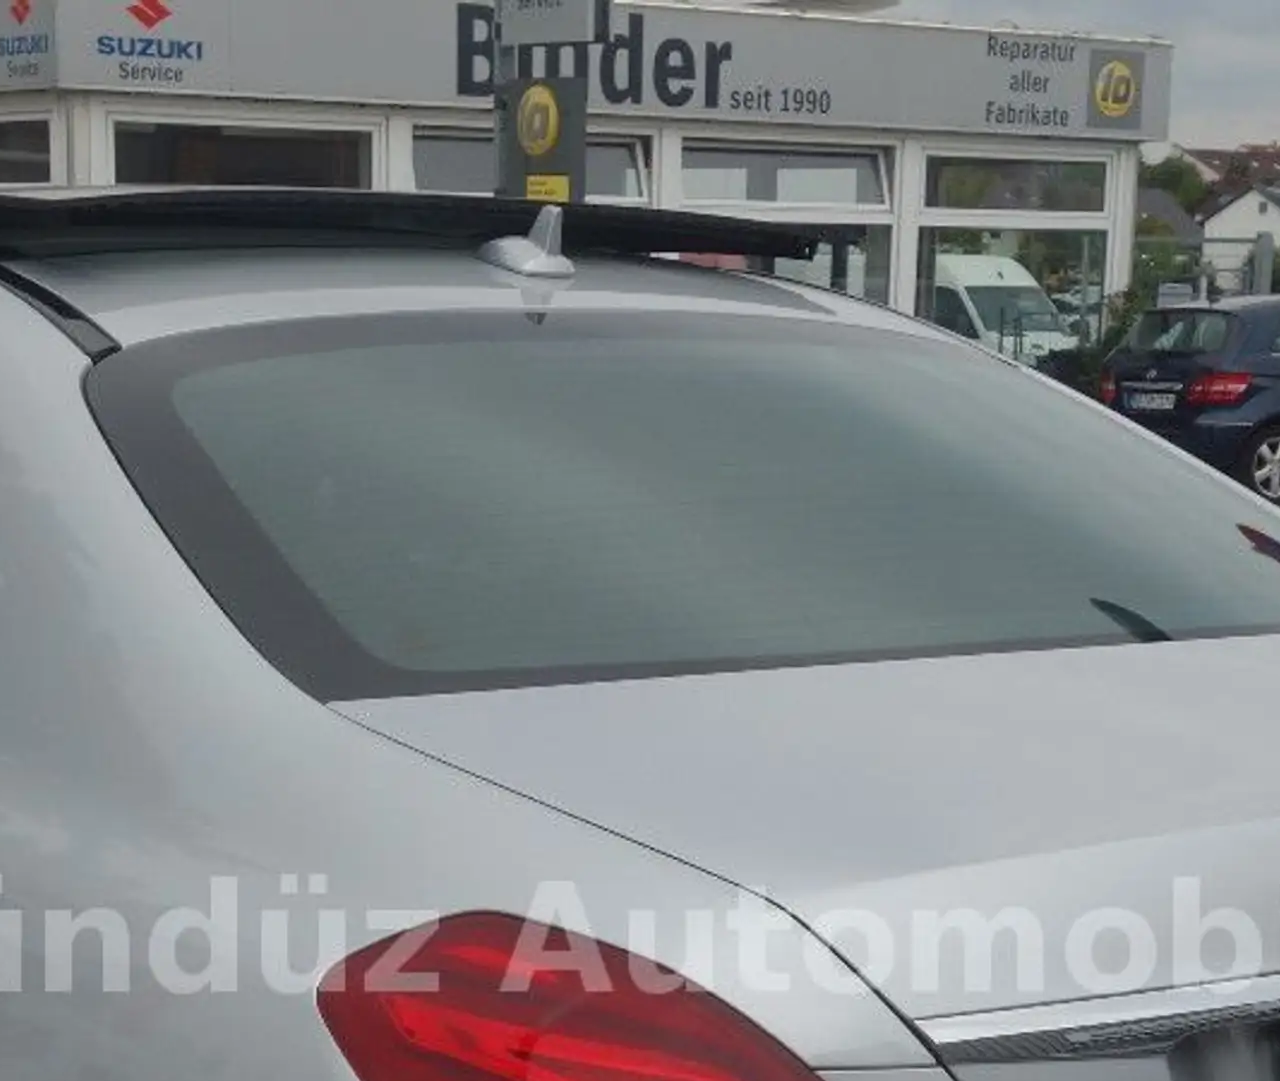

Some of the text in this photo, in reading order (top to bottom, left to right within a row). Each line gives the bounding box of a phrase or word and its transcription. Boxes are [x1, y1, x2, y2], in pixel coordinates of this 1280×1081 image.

[96, 35, 203, 60] SUZUKI
[986, 35, 1076, 62] Reparatur
[119, 62, 183, 82] Service
[1009, 71, 1050, 94] aller
[730, 89, 771, 112] seit
[779, 88, 832, 115] 1990
[985, 101, 1070, 126] Fabrikate
